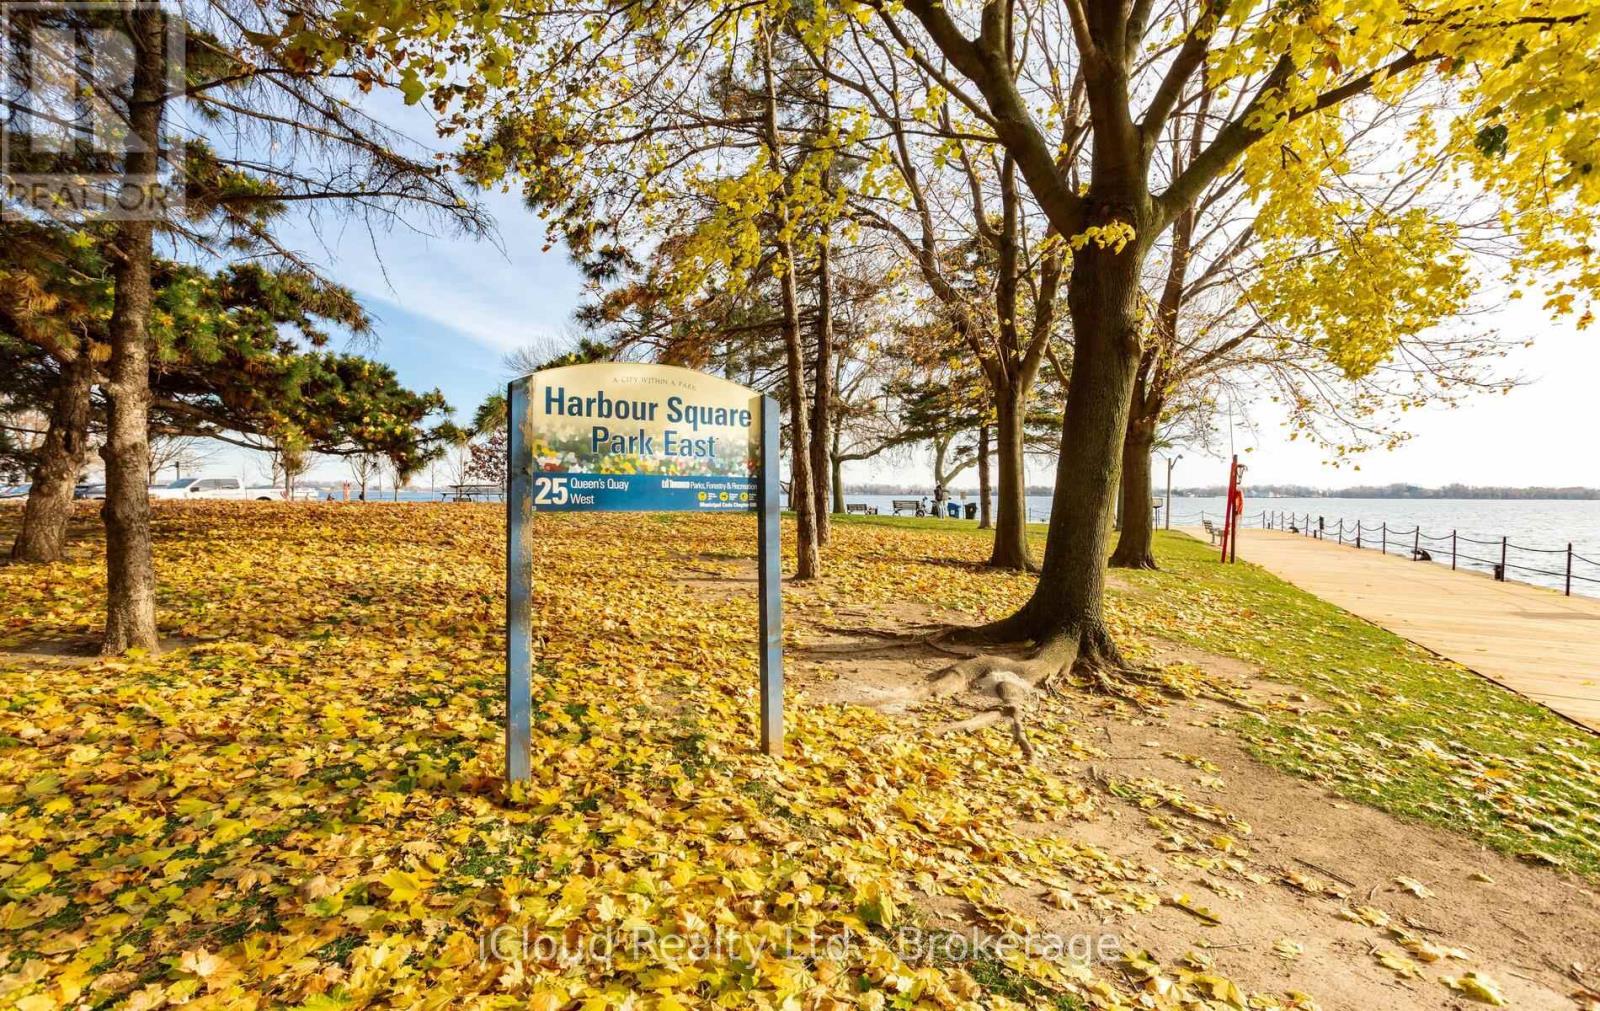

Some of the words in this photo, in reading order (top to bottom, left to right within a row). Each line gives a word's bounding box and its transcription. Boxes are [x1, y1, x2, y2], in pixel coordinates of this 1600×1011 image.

[612, 376, 618, 384] A
[621, 376, 638, 385] CITY
[641, 376, 668, 385] WITHIN
[678, 381, 697, 391] PARK
[545, 386, 659, 421] Harbour
[667, 396, 752, 431] Square
[592, 426, 653, 455] Park
[664, 430, 716, 457] East
[534, 477, 568, 505] 25
[570, 477, 605, 490] Queen's
[607, 478, 629, 491] Quay
[570, 493, 595, 504] West
